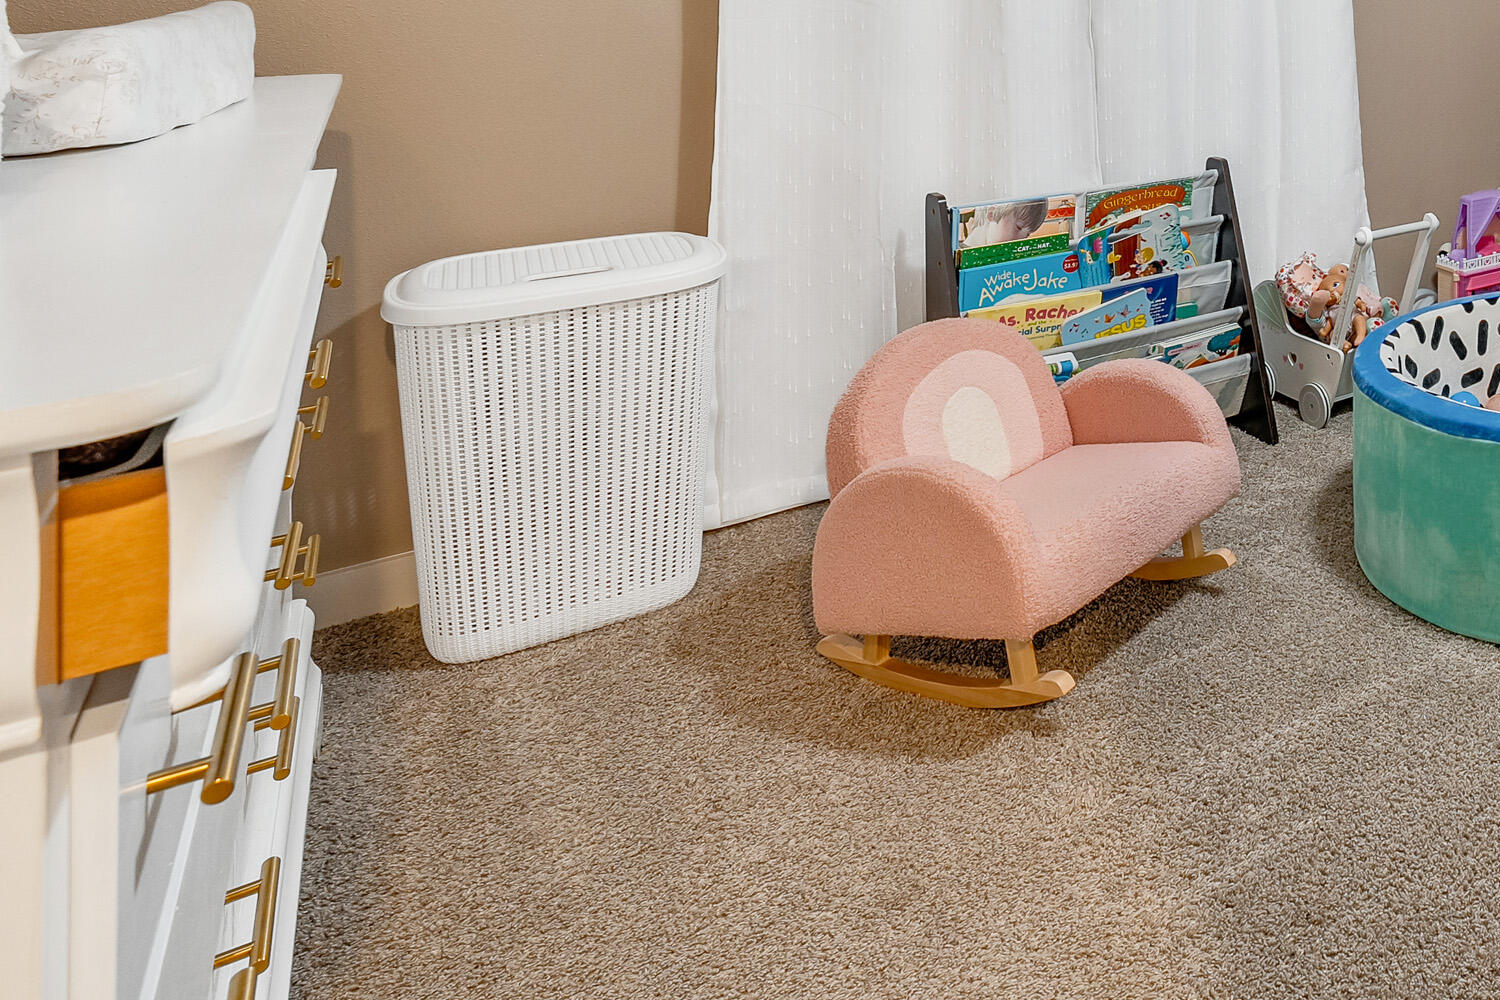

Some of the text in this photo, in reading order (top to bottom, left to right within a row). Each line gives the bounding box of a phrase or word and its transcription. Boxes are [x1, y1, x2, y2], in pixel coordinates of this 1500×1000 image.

[1103, 187, 1179, 210] Gingerbread
[984, 270, 1011, 287] Wide
[1024, 268, 1069, 291] Jake
[1024, 304, 1084, 322] Rache
